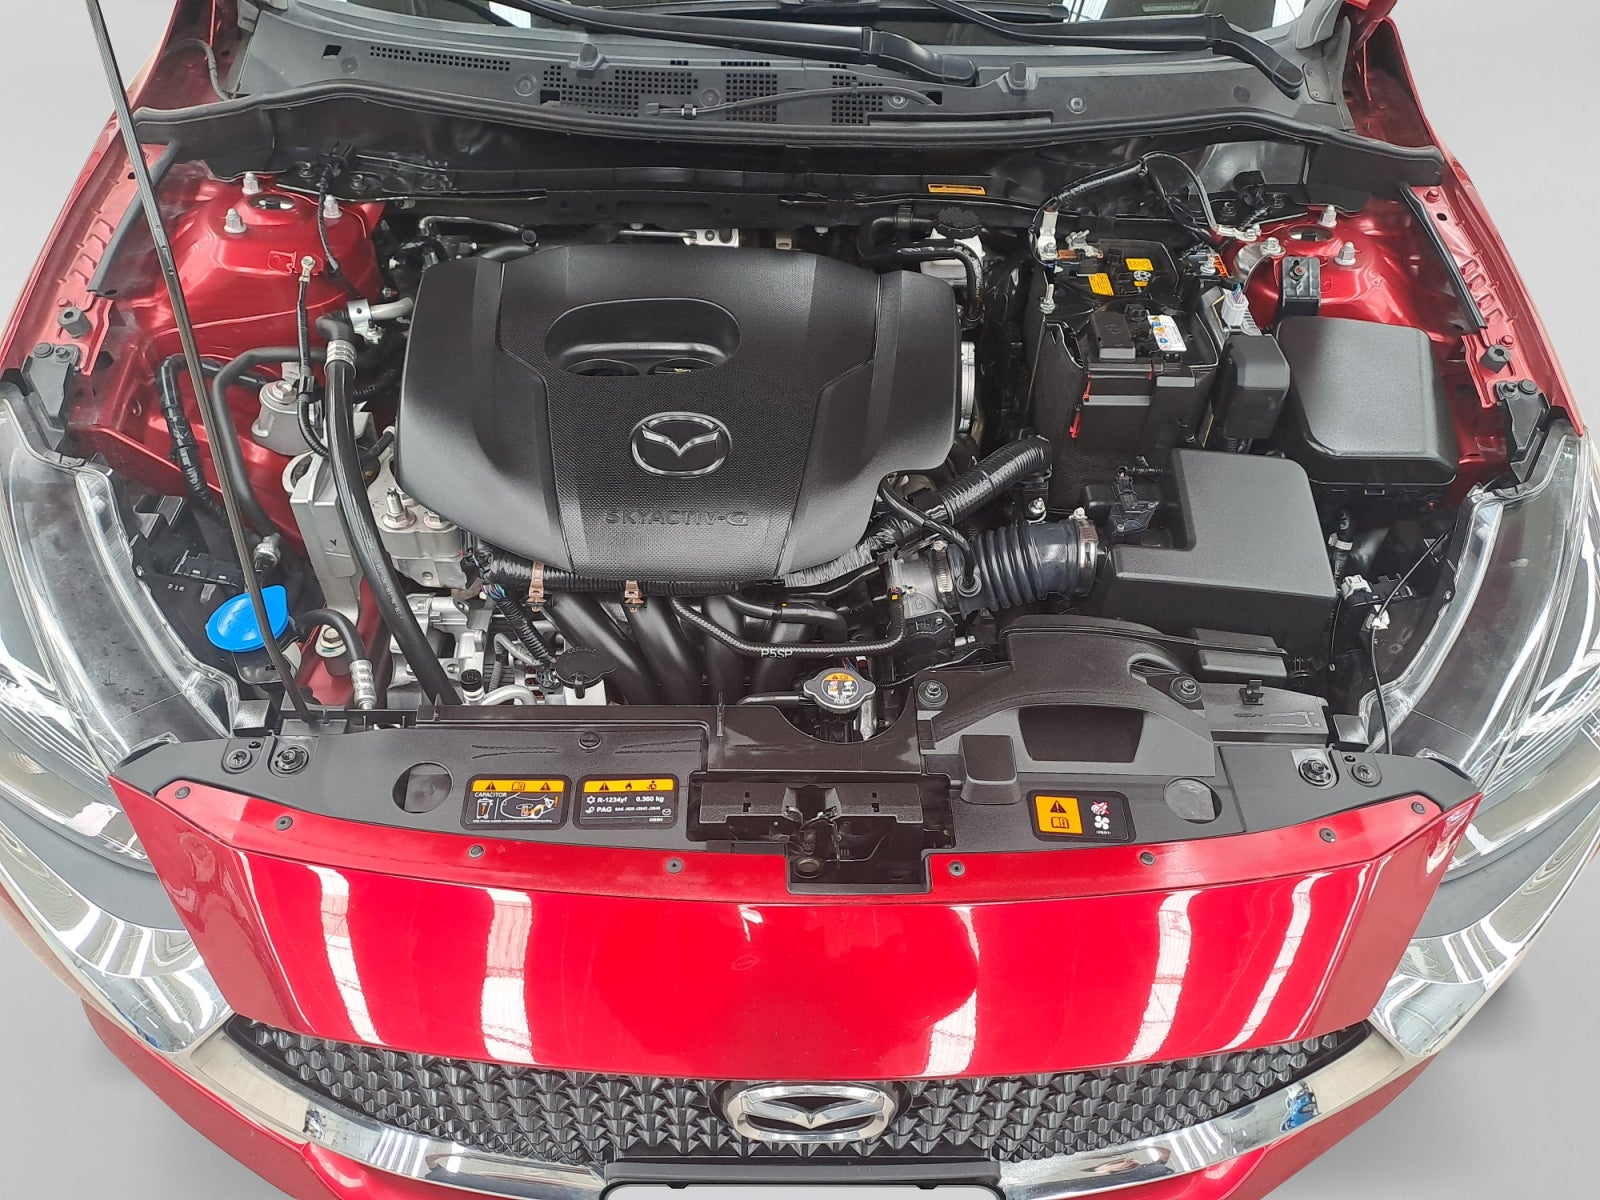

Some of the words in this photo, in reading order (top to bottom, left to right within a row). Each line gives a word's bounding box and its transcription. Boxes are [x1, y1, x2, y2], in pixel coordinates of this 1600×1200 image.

[605, 510, 748, 526] SKYACTIV-G
[760, 648, 793, 658] P5SP
[597, 796, 628, 804] R-1234yf
